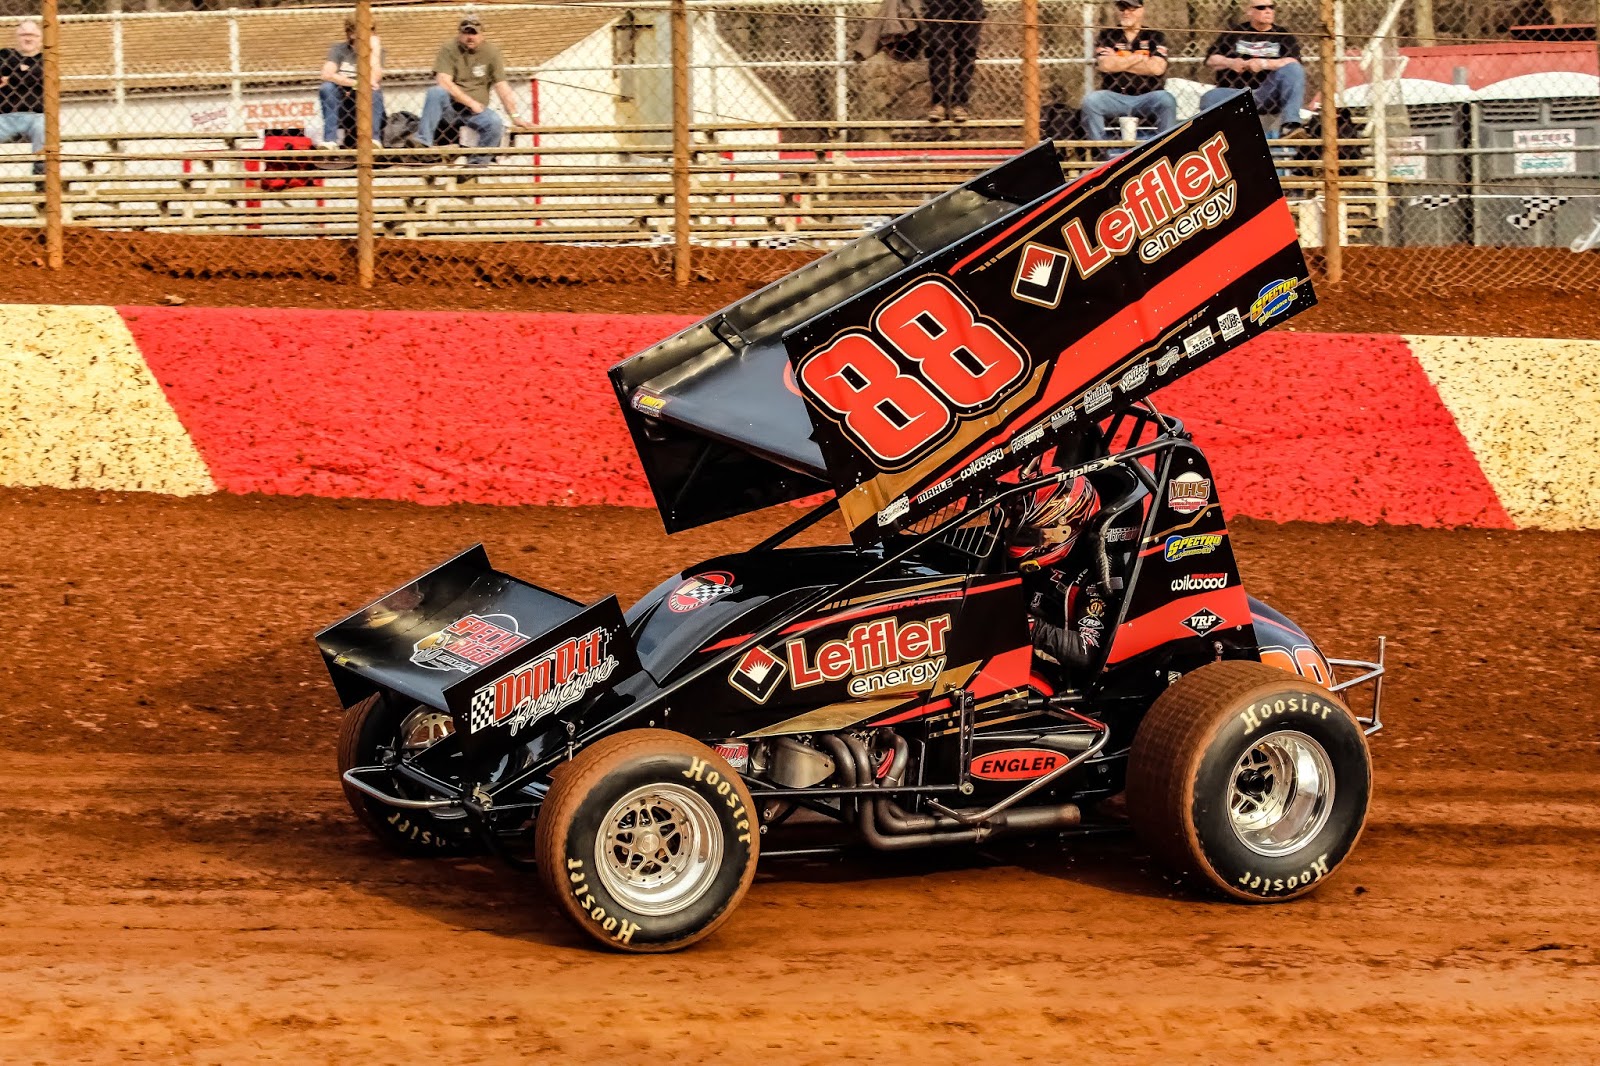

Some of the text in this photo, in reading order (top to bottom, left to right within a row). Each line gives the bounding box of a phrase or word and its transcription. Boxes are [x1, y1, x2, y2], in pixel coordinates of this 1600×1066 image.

[243, 101, 316, 118] RENCH
[1063, 134, 1230, 277] Leffler
[1141, 182, 1235, 261] energy
[1251, 277, 1298, 323] SPECTRO
[1192, 336, 1212, 350] ROD
[801, 280, 1024, 461] 88
[1051, 405, 1074, 422] ALL PRO
[960, 448, 1004, 480] wilwood
[918, 479, 953, 503] MAHLE
[1169, 479, 1210, 500] MHS
[1167, 536, 1222, 558] SPECTRO
[1171, 573, 1228, 591] wilwood
[1191, 615, 1217, 627] VRP
[788, 616, 949, 687] Leffler
[493, 629, 602, 722] Don Ott
[509, 654, 619, 736] Racing Engines
[850, 657, 946, 697] energy
[1240, 694, 1332, 735] Hoosier
[980, 756, 1057, 774] ENGLER
[682, 756, 751, 843] Hoosier
[1239, 854, 1329, 895] Hoosier
[568, 858, 641, 944] Hoosier
